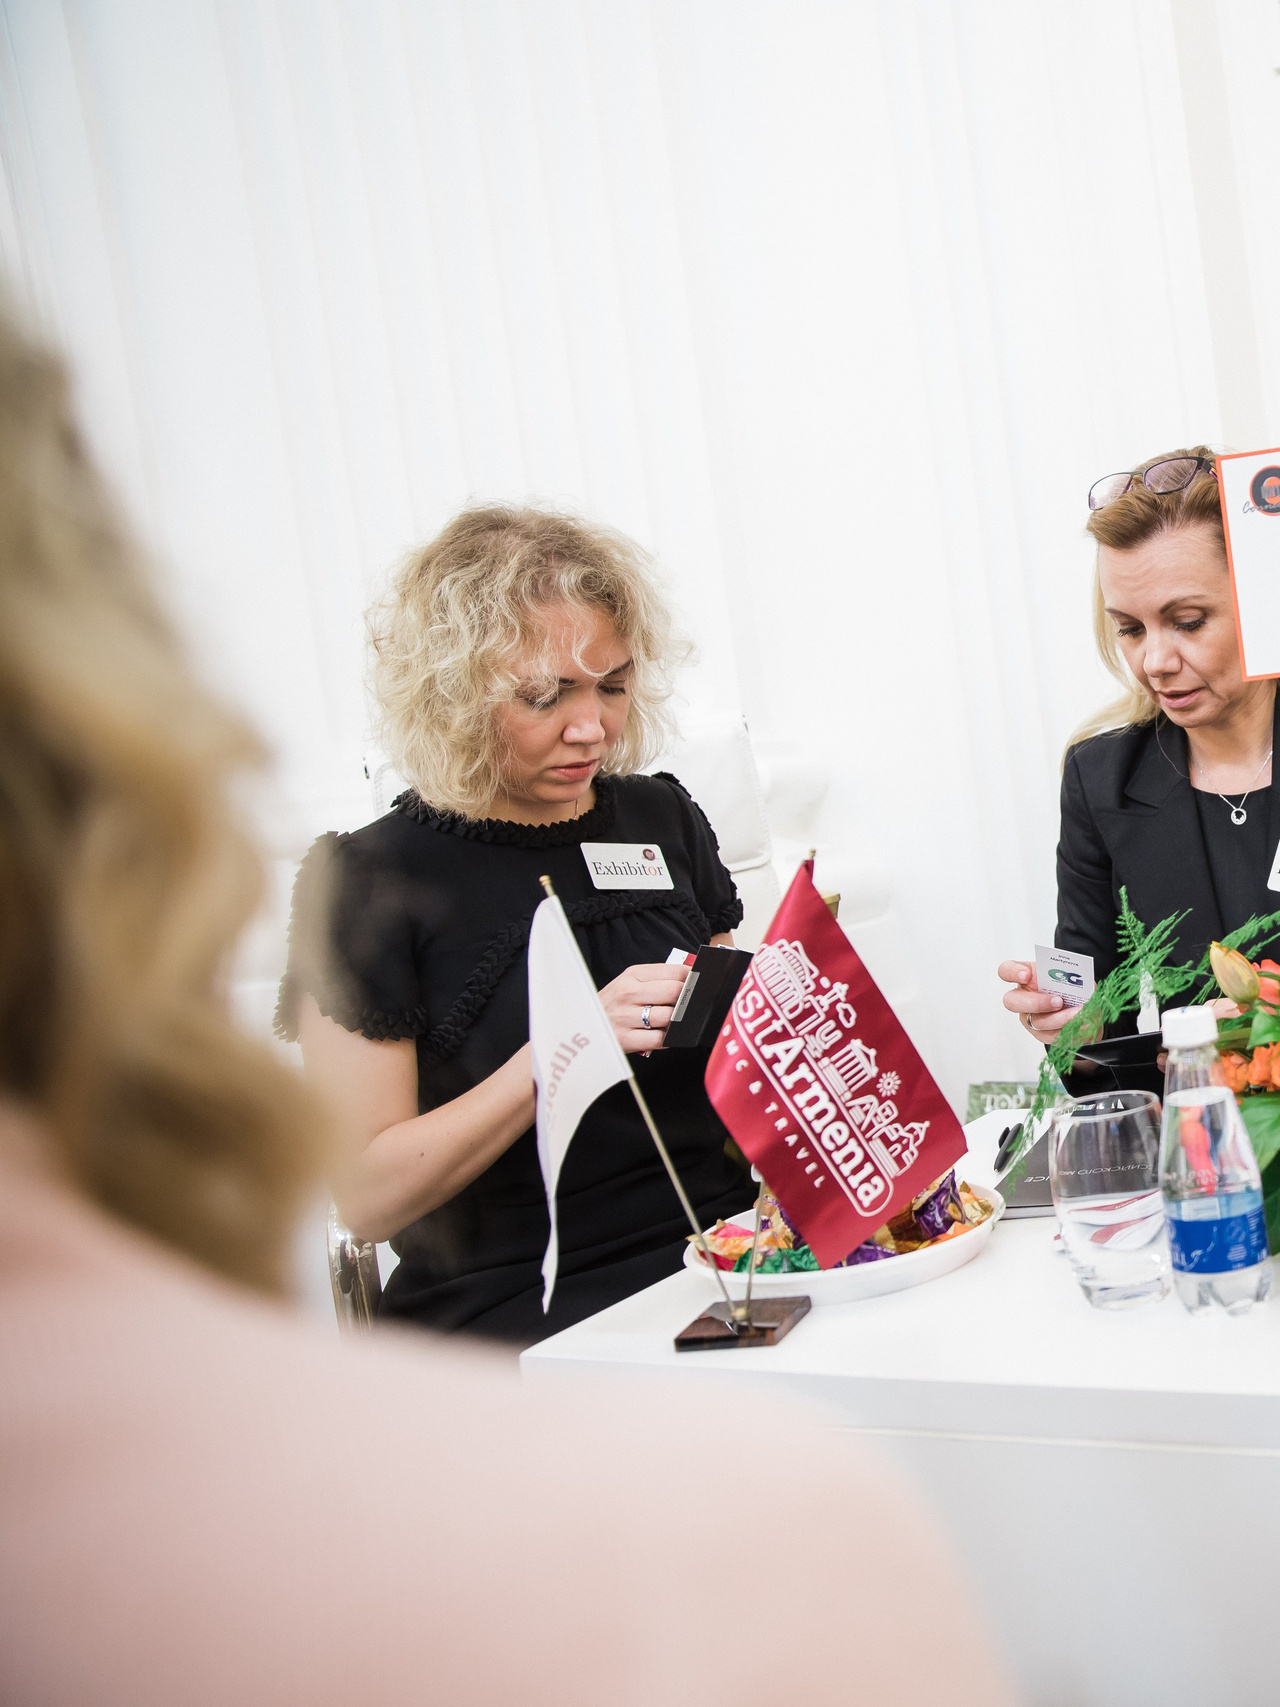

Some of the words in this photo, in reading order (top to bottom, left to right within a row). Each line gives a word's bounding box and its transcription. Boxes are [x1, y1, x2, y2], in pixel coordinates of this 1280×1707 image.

[591, 861, 664, 876] Exhibitor
[735, 970, 885, 1208] isitArmenia
[764, 1101, 826, 1189] TRAVEL
